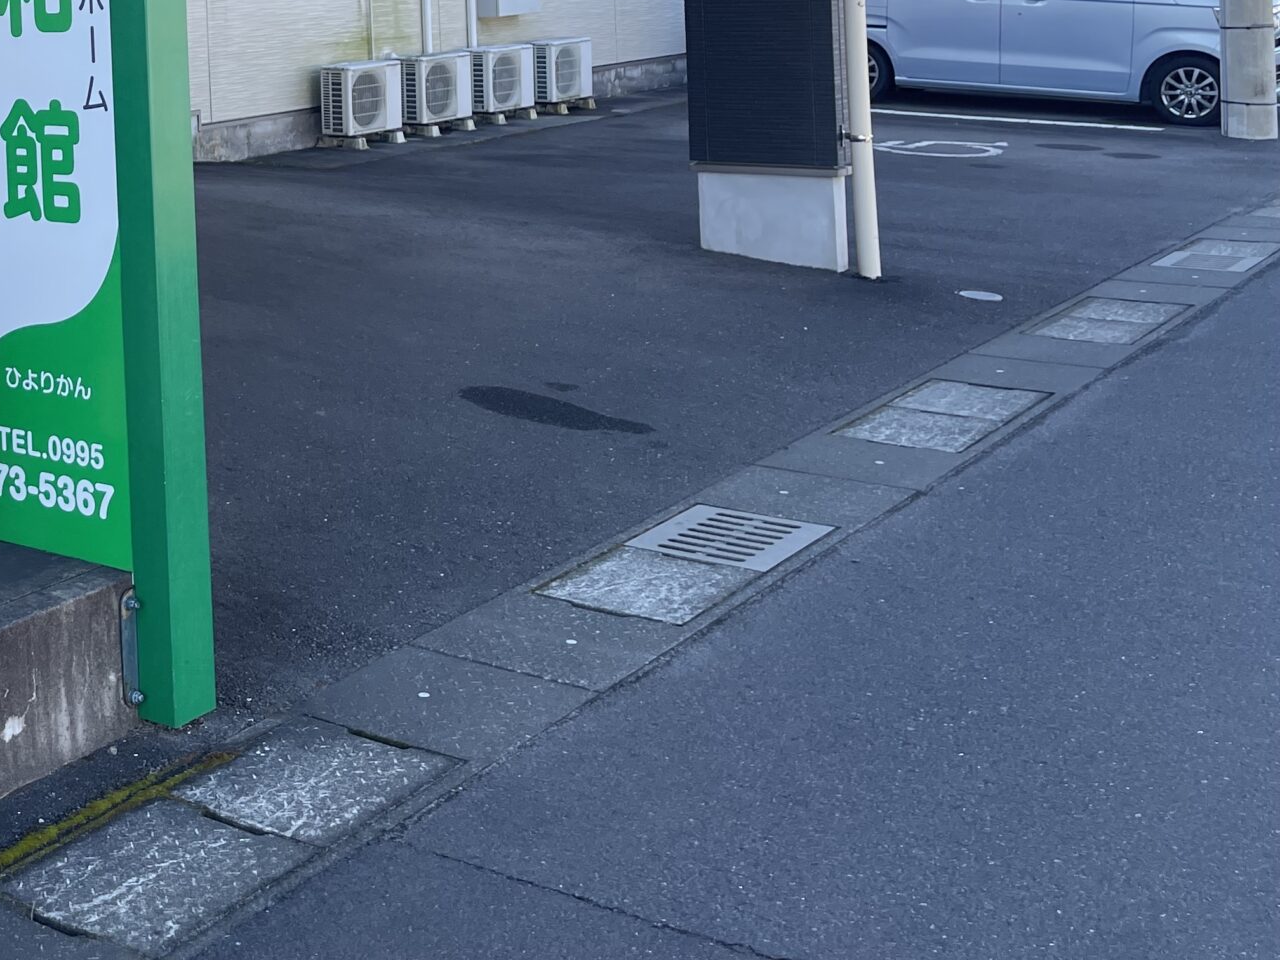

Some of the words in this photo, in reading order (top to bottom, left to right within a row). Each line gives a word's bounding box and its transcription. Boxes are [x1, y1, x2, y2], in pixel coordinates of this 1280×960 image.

[5, 367, 91, 400] ひよりかん
